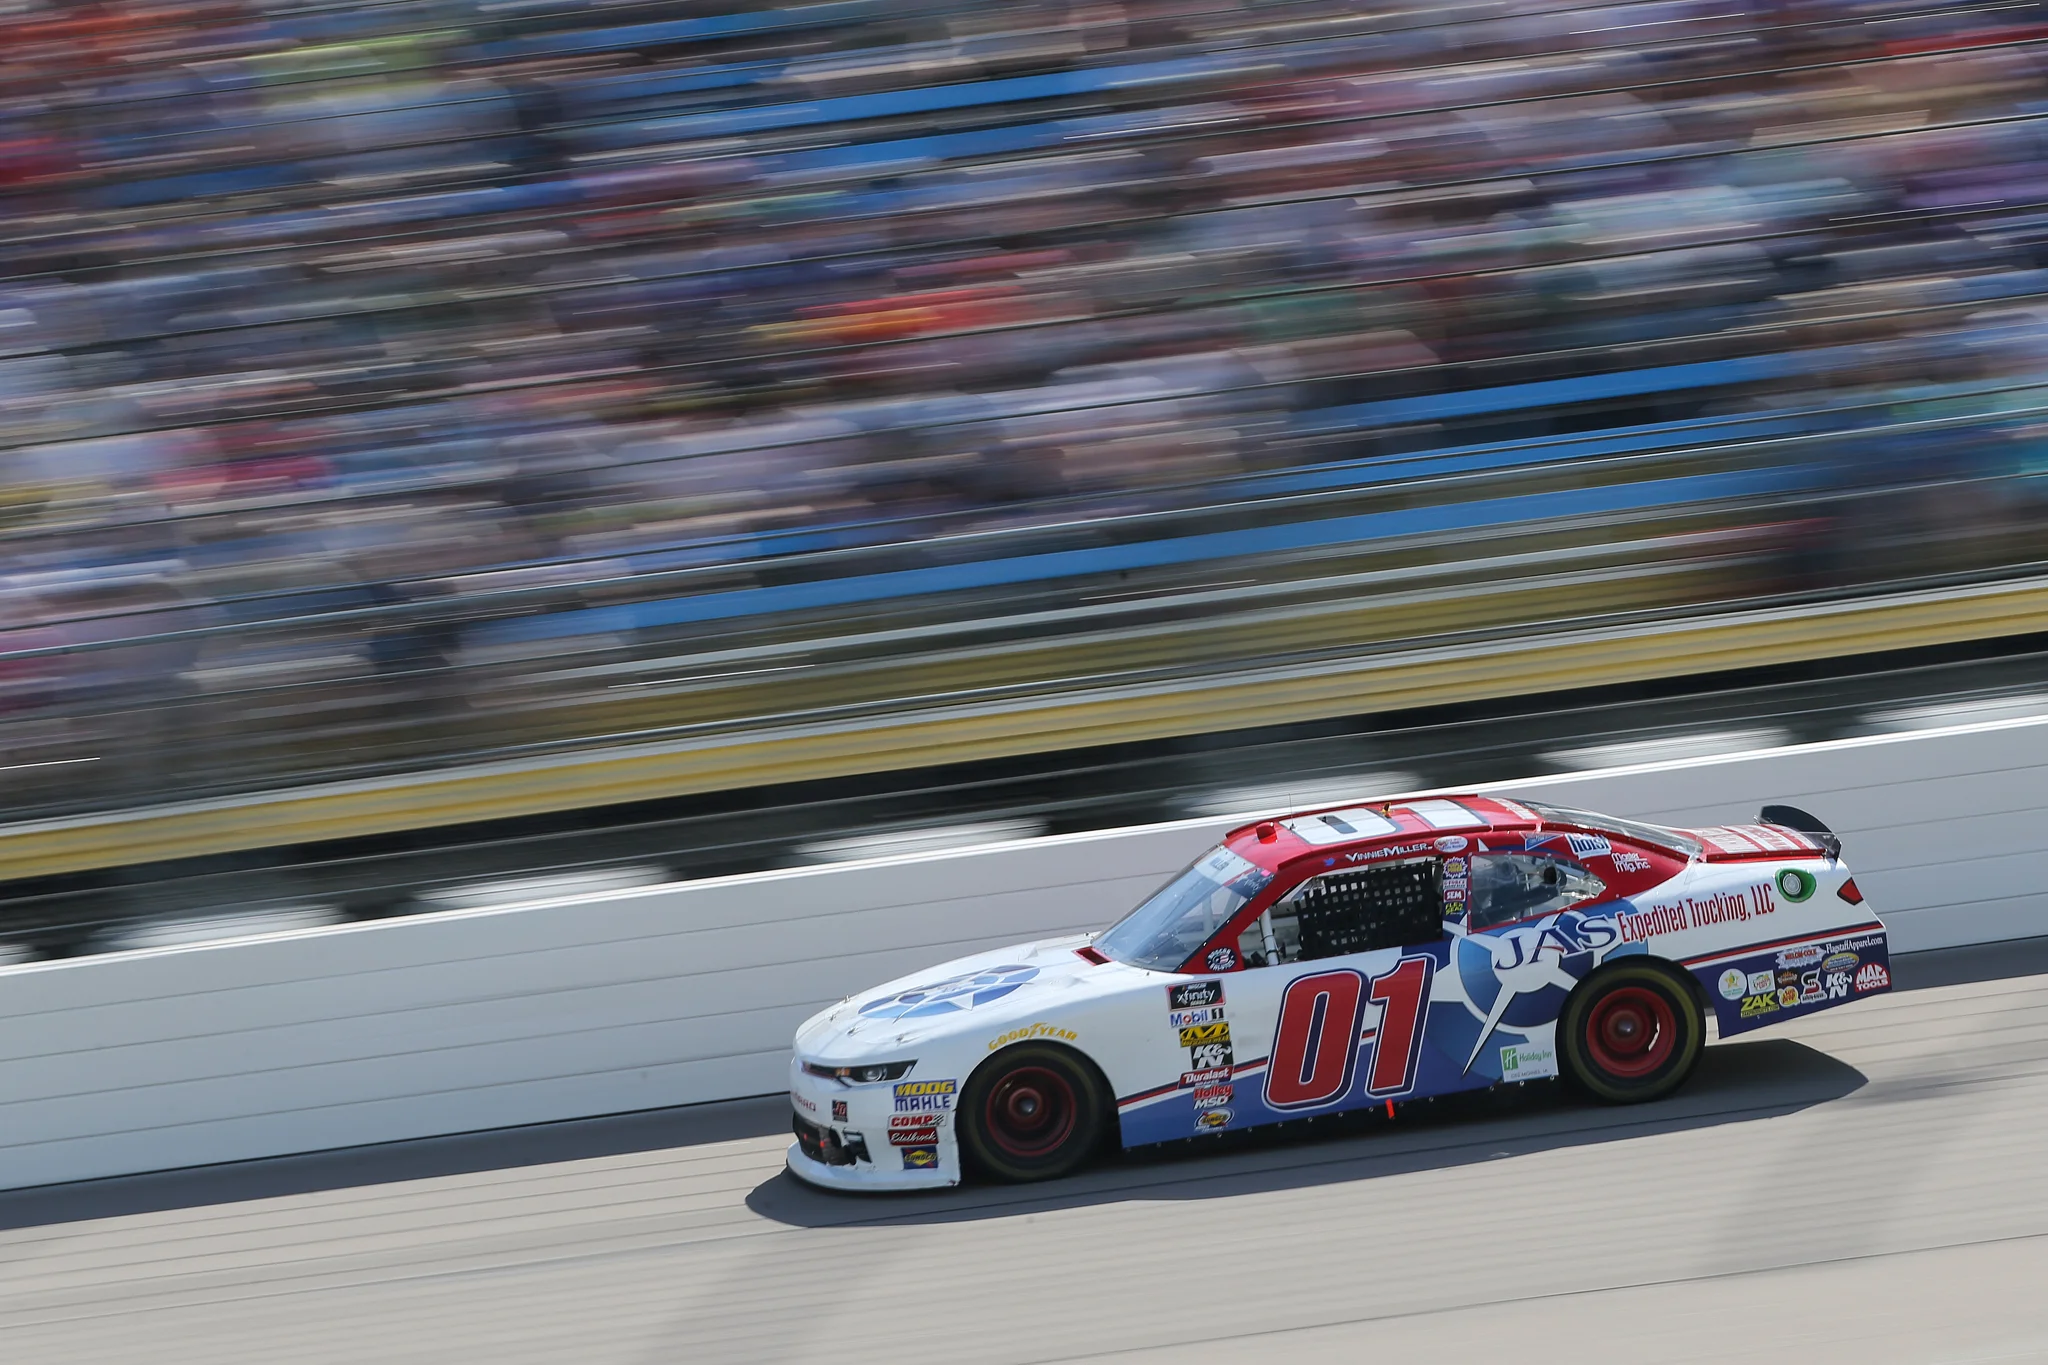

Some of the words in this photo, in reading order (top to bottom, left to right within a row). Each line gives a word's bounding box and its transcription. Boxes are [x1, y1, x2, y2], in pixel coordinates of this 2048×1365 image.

[1446, 890, 1462, 900] SEM
[1495, 914, 1617, 970] JAS
[1617, 899, 1688, 943] Expedited
[1689, 892, 1751, 928] Trucking,
[1751, 883, 1775, 916] LLC
[1856, 964, 1888, 984] MAC
[1856, 978, 1888, 991] TOOLS
[1177, 989, 1215, 1004] xfinity
[1741, 992, 1776, 1011] ZAK
[1170, 1009, 1208, 1027] Mobil
[988, 1022, 1078, 1050] GOODYEAR
[1263, 954, 1436, 1112] 01
[1519, 1052, 1541, 1063] Holiday
[1542, 1050, 1552, 1060] Inn
[1183, 1067, 1229, 1084] Duralast
[896, 1082, 955, 1096] MOOG
[1194, 1084, 1233, 1100] Holley
[895, 1096, 950, 1111] MAHLE
[1194, 1096, 1228, 1110] MSD
[891, 1114, 933, 1127] COMP
[892, 1131, 936, 1143] Edelbrock
[904, 1153, 936, 1162] SUNOCO
